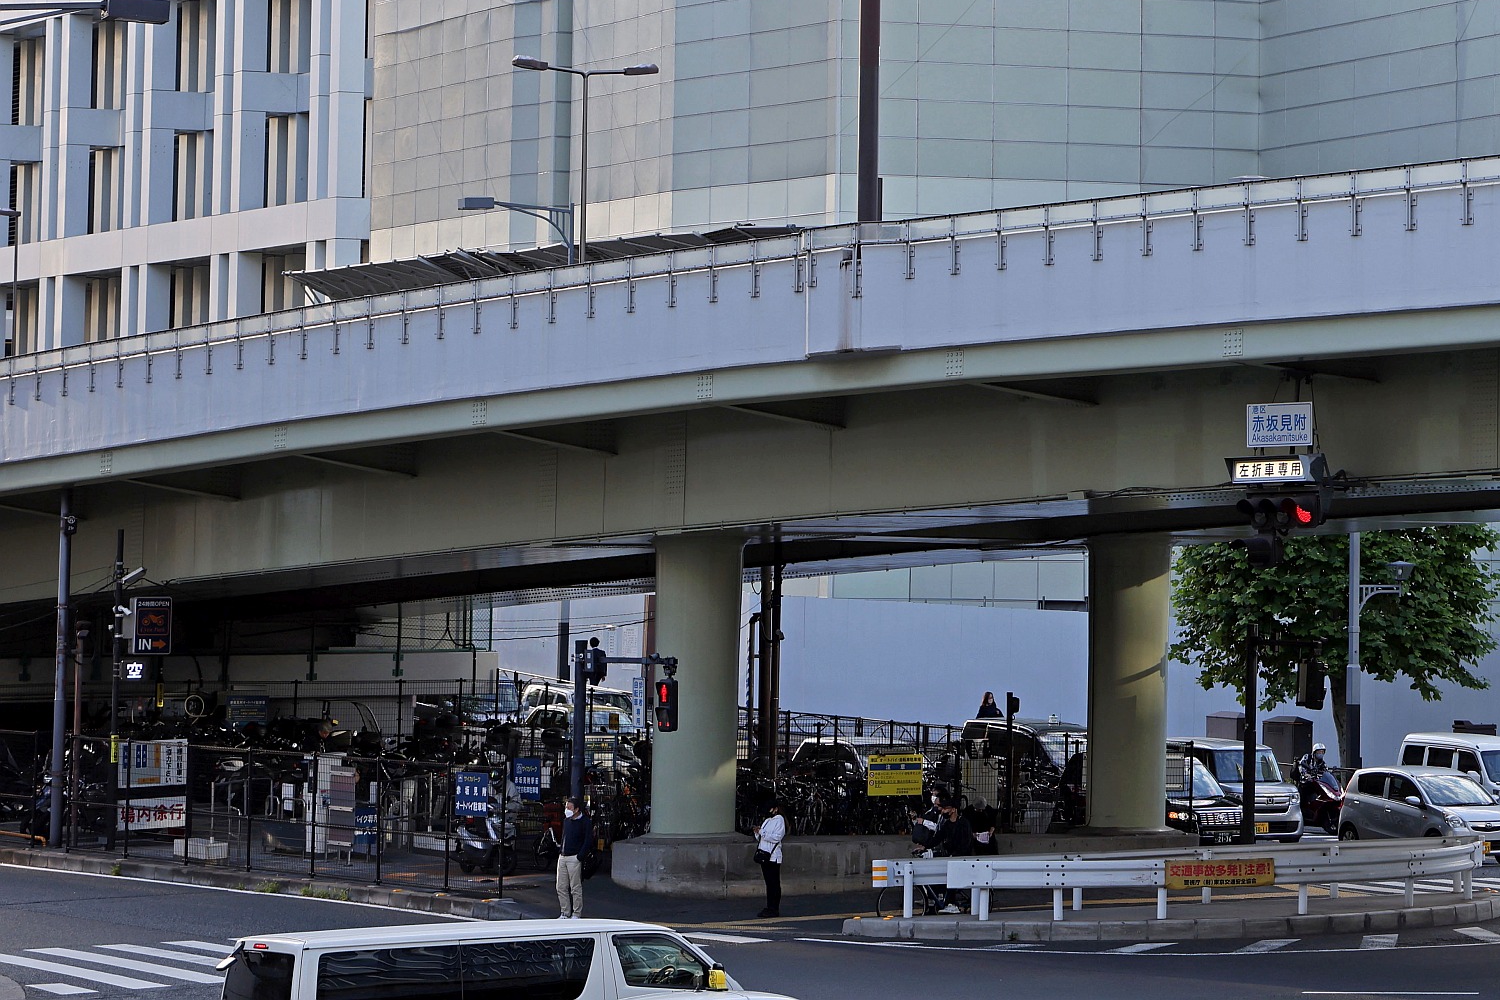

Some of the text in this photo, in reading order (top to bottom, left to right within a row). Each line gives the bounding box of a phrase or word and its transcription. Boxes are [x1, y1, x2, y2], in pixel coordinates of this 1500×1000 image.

[1251, 405, 1266, 414] 港区
[1252, 413, 1307, 432] 赤坂見附
[1251, 433, 1308, 443] Akasakamitsuke
[1239, 462, 1301, 477] 左折車専用
[138, 638, 152, 651] IN
[126, 661, 143, 679] 空
[456, 785, 487, 797] 赤坂見附
[455, 800, 487, 812] オートバイ駐車場
[120, 803, 184, 823] 場内徐行
